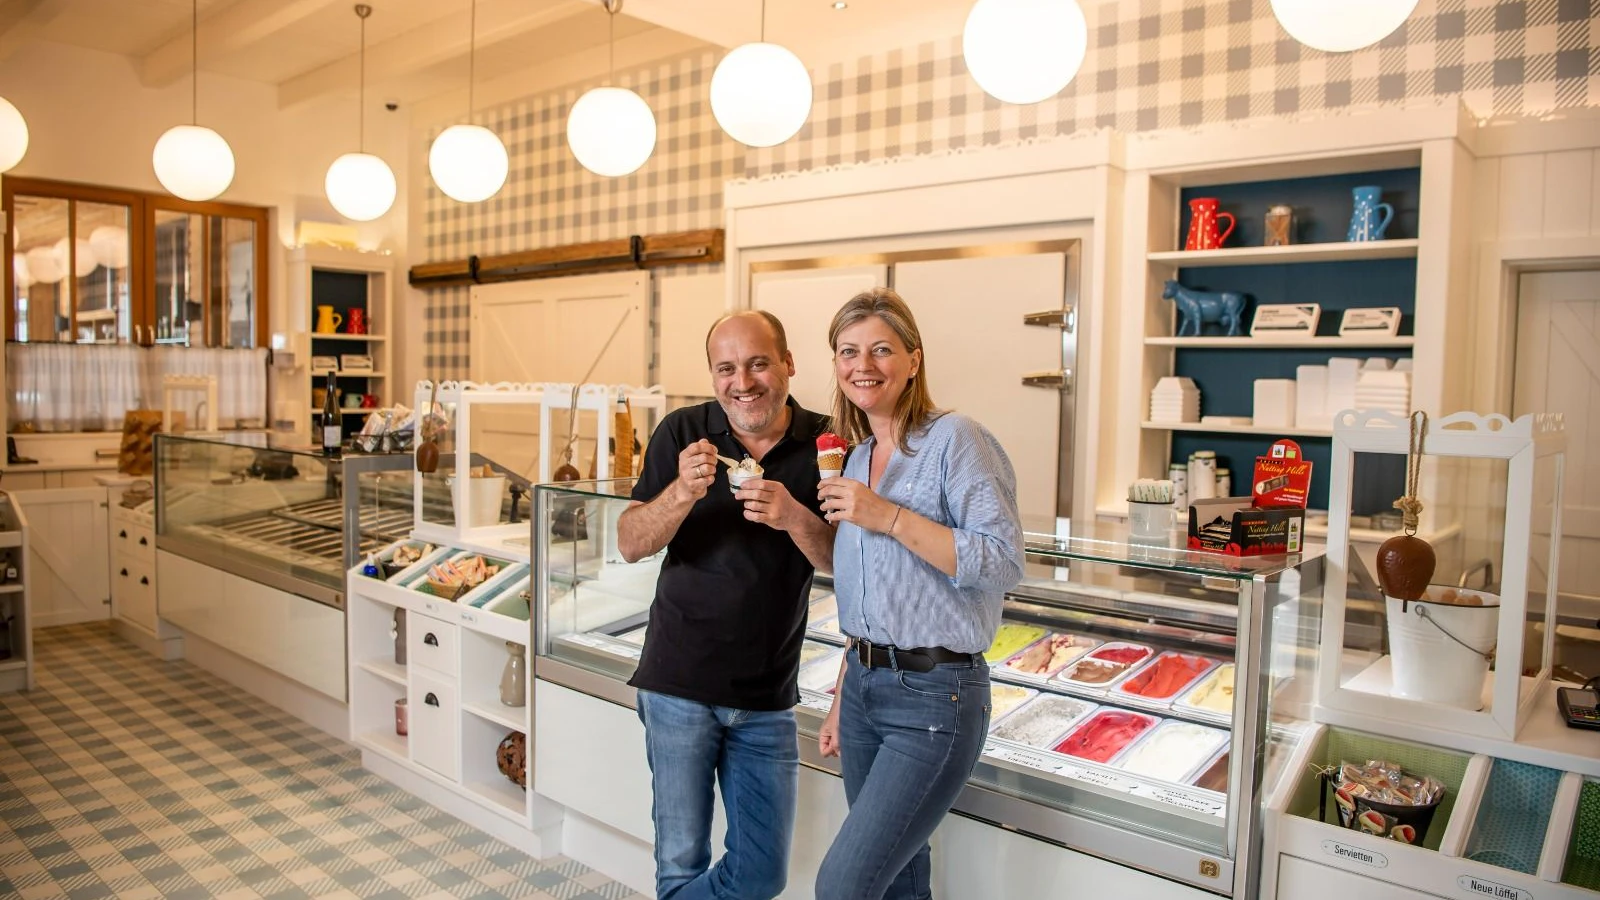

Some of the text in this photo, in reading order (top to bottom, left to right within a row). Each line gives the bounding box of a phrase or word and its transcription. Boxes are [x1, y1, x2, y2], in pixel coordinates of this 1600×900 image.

[1334, 844, 1373, 863] Servietten
[1471, 879, 1518, 900] Neue Löffel
